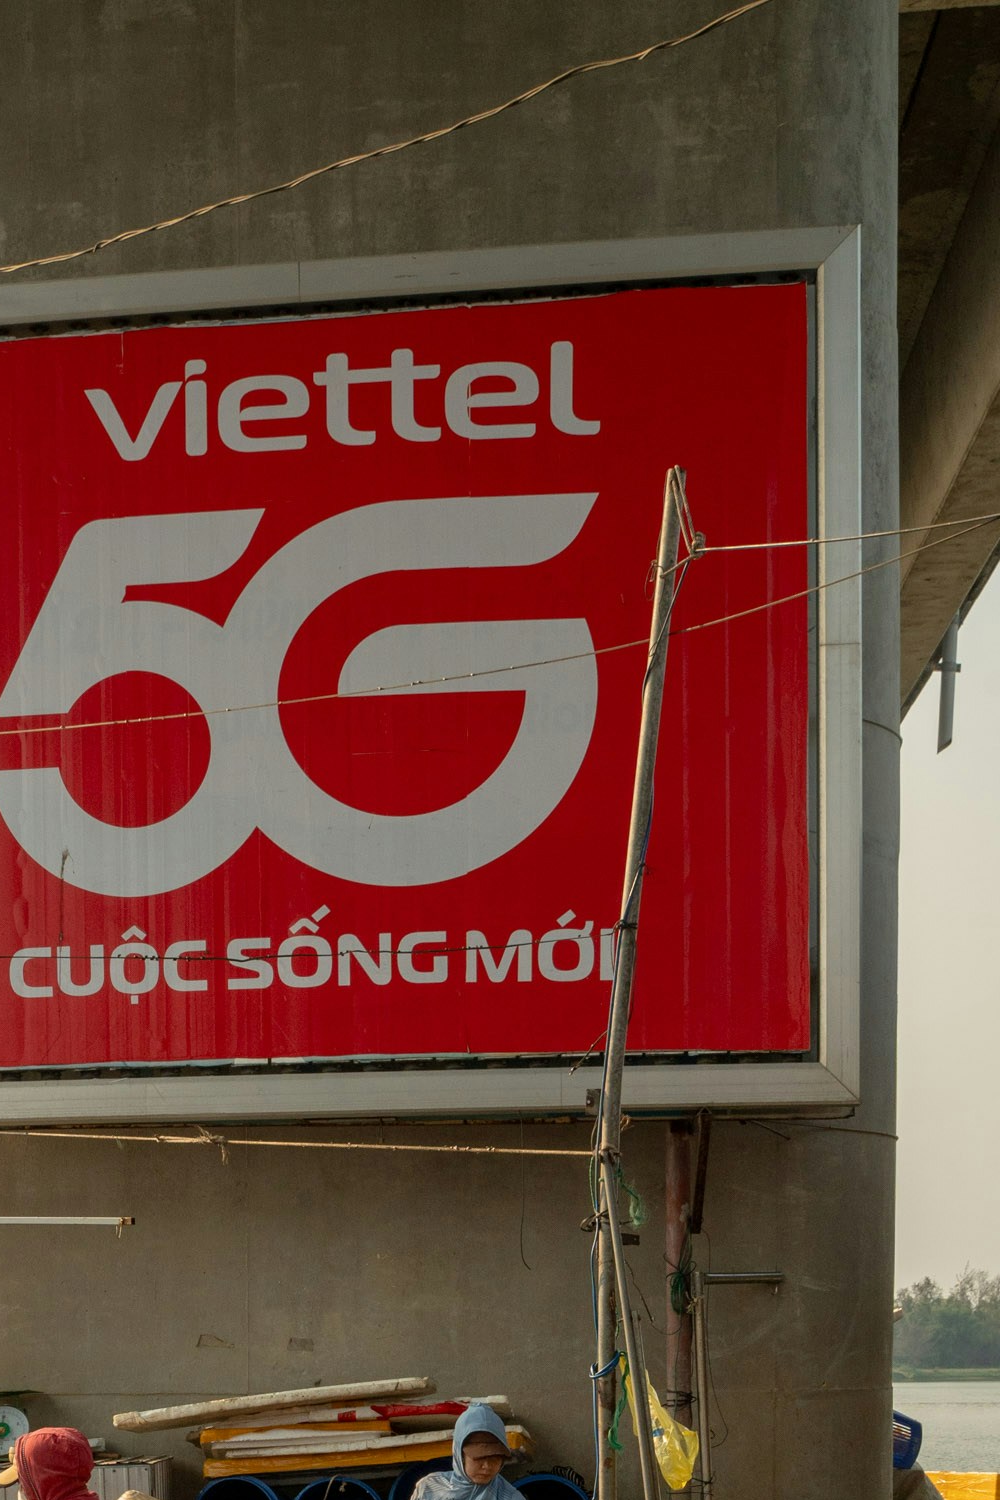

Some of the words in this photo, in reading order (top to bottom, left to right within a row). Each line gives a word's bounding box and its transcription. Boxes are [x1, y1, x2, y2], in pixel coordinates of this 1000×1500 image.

[84, 340, 600, 461] viettel
[9, 924, 208, 1004] CUỘC
[226, 905, 449, 990] SỐNG
